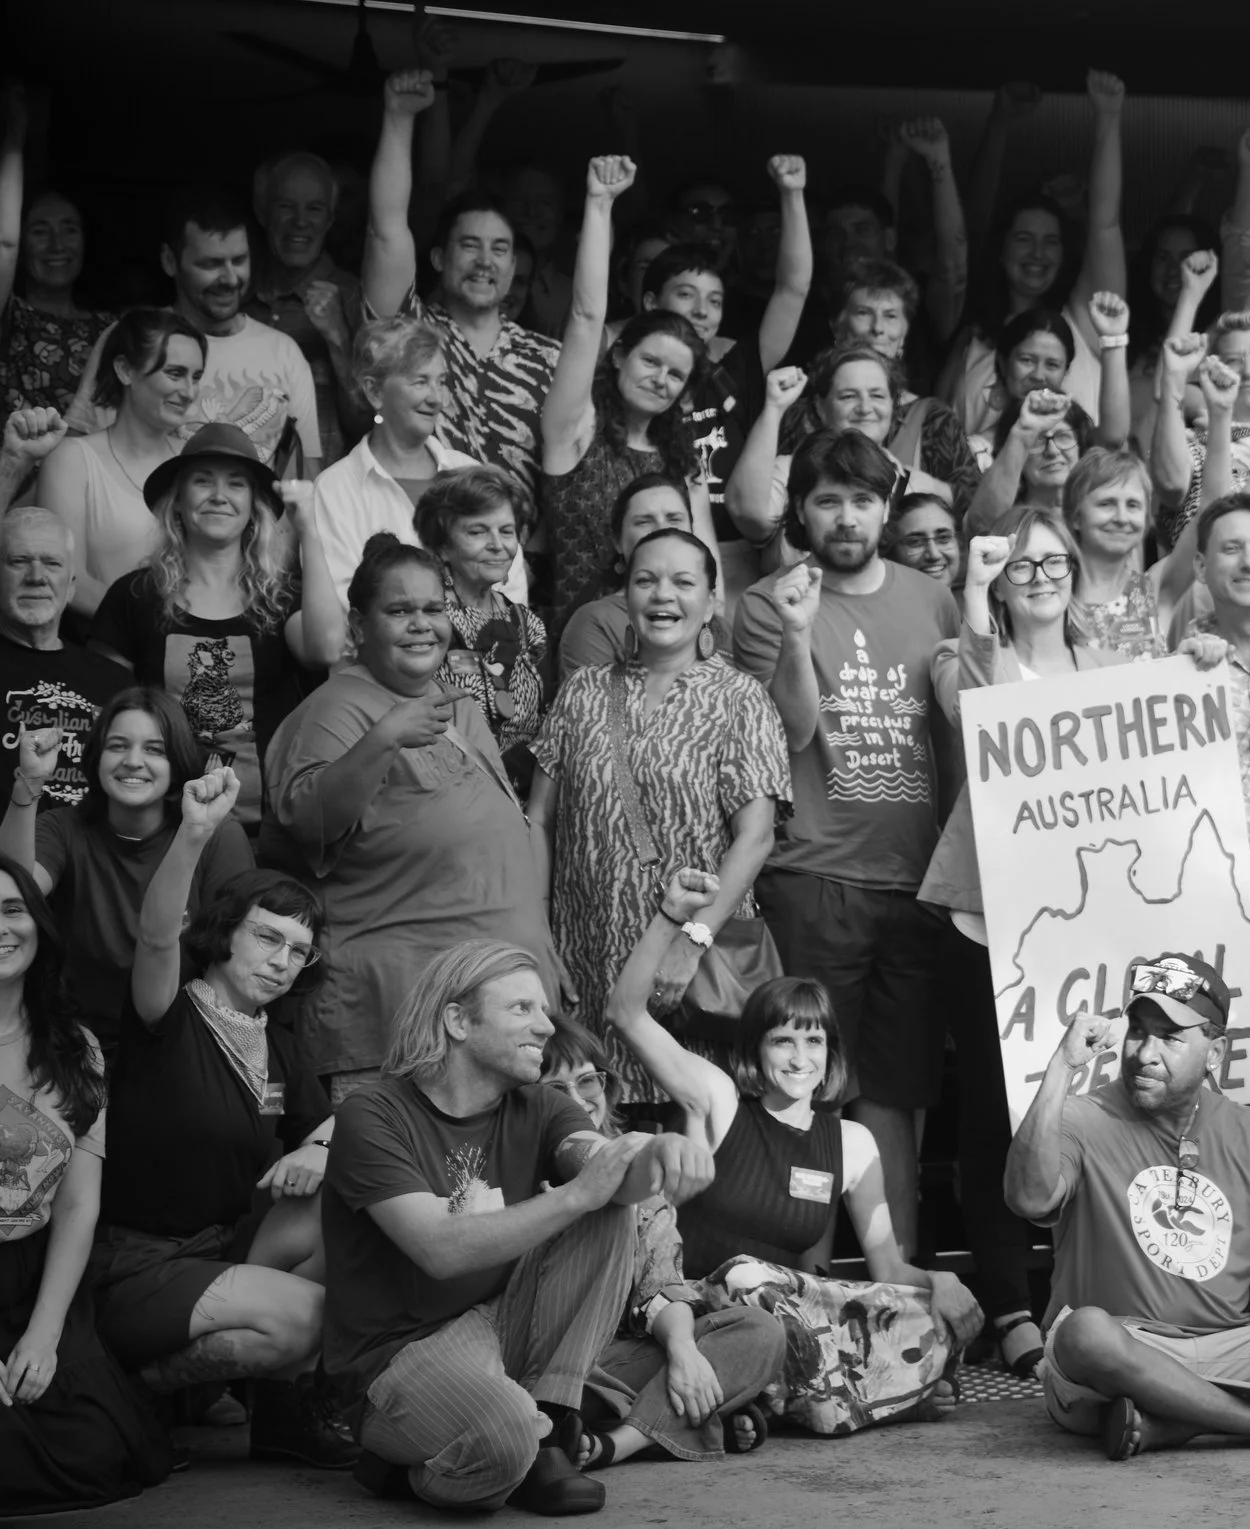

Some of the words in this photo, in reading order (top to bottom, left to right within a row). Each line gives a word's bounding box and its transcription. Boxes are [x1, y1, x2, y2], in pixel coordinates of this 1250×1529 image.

[856, 649, 869, 664] a
[839, 662, 878, 684] drop
[887, 664, 908, 690] of
[840, 685, 900, 701] water
[856, 701, 873, 715] is
[840, 715, 912, 733] precious
[863, 732, 884, 746] in
[888, 729, 914, 747] the
[978, 685, 1232, 782] NORTHERN
[845, 748, 901, 769] Desert
[1013, 774, 1197, 834] AUSTRALIA
[1000, 986, 1036, 1041] A
[1163, 1232, 1189, 1247] 120
